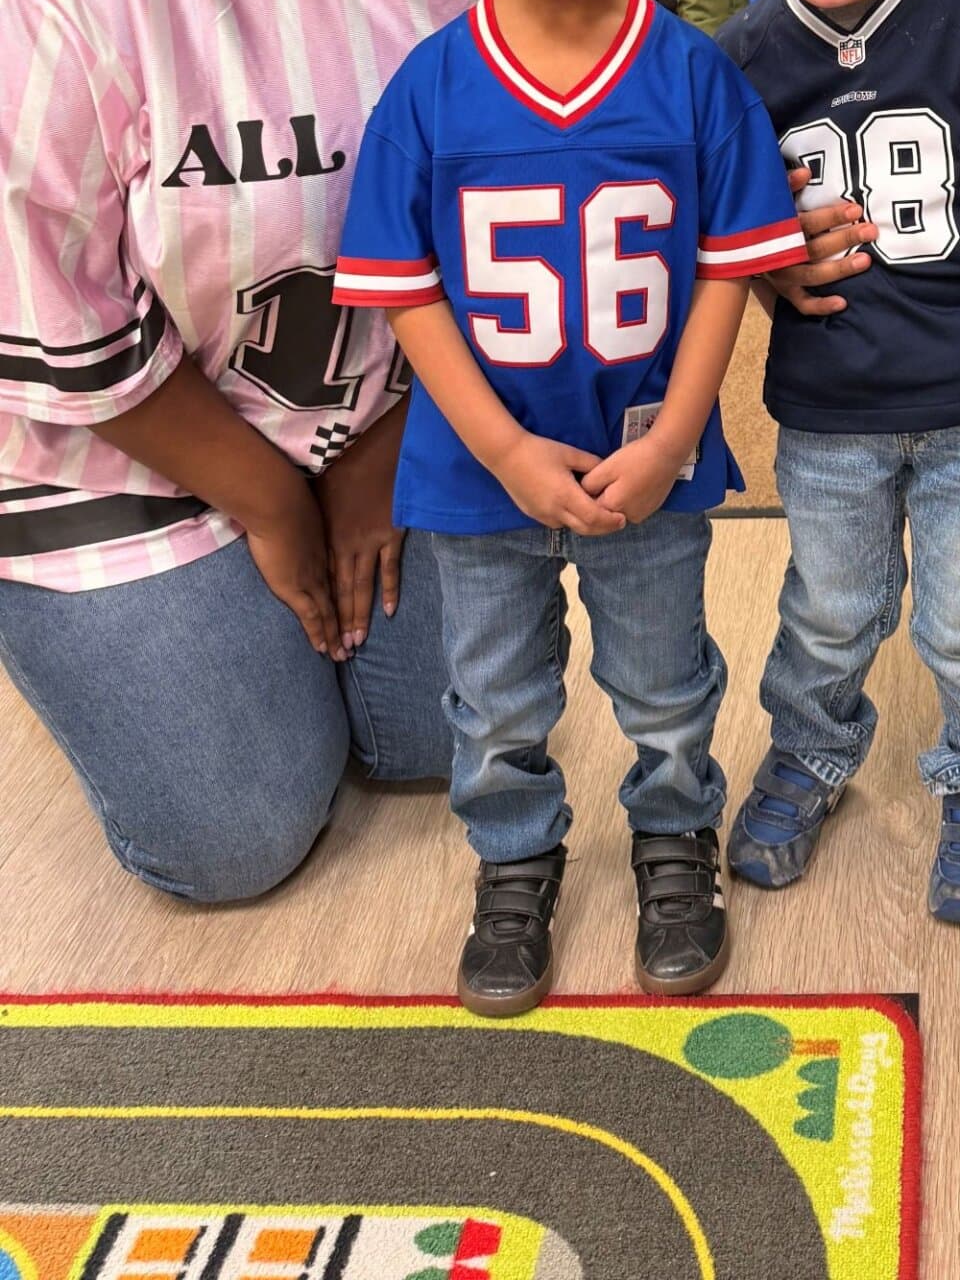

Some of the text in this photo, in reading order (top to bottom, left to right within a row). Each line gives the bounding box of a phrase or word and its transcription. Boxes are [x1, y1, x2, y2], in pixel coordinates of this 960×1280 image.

[161, 114, 346, 188] ALL
[228, 265, 412, 412] 1
[458, 178, 677, 368] 56
